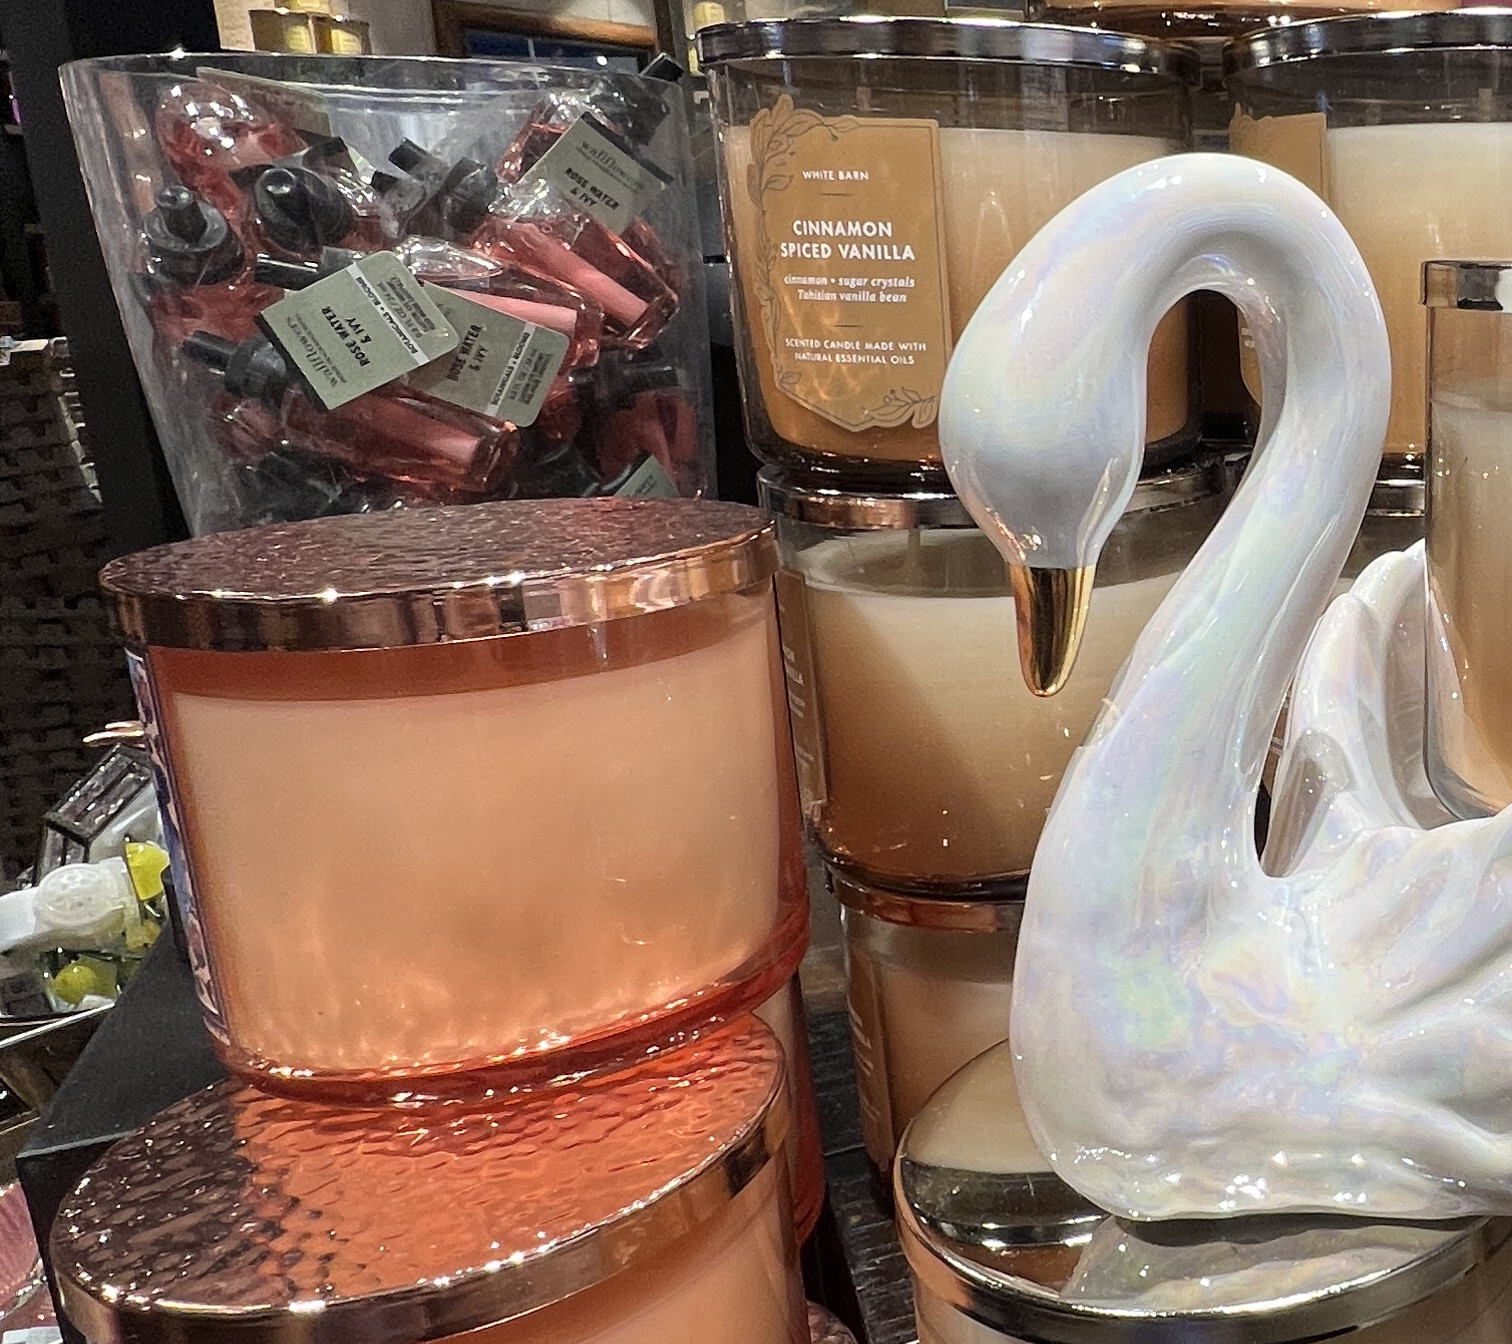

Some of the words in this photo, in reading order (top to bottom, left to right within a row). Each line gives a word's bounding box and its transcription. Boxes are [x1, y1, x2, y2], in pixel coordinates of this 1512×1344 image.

[563, 166, 589, 189] ROSE
[802, 170, 834, 180] WHITE
[839, 171, 869, 180] BARN
[578, 192, 598, 209] IVY
[793, 220, 892, 237] CINNAMON
[780, 242, 831, 258] SPICED
[838, 244, 915, 260] VANILLA
[784, 274, 827, 286] cinnamon
[839, 277, 868, 288] sugar
[871, 276, 915, 289] crystals
[798, 289, 836, 301] Tahitian
[839, 290, 876, 302] vanilla
[880, 292, 906, 302] bean
[321, 306, 351, 341] WATER
[344, 317, 365, 335] IVY
[457, 321, 482, 357] WATER
[785, 338, 821, 348] SCENTED
[824, 339, 861, 350] CANDLE
[865, 342, 894, 350] MADE
[899, 342, 927, 351] WITH
[345, 340, 370, 367] ROSE
[473, 344, 489, 363] IVY
[795, 353, 832, 362] NATURAL
[836, 354, 886, 364] ESSENTIAL
[891, 355, 915, 365] OILS
